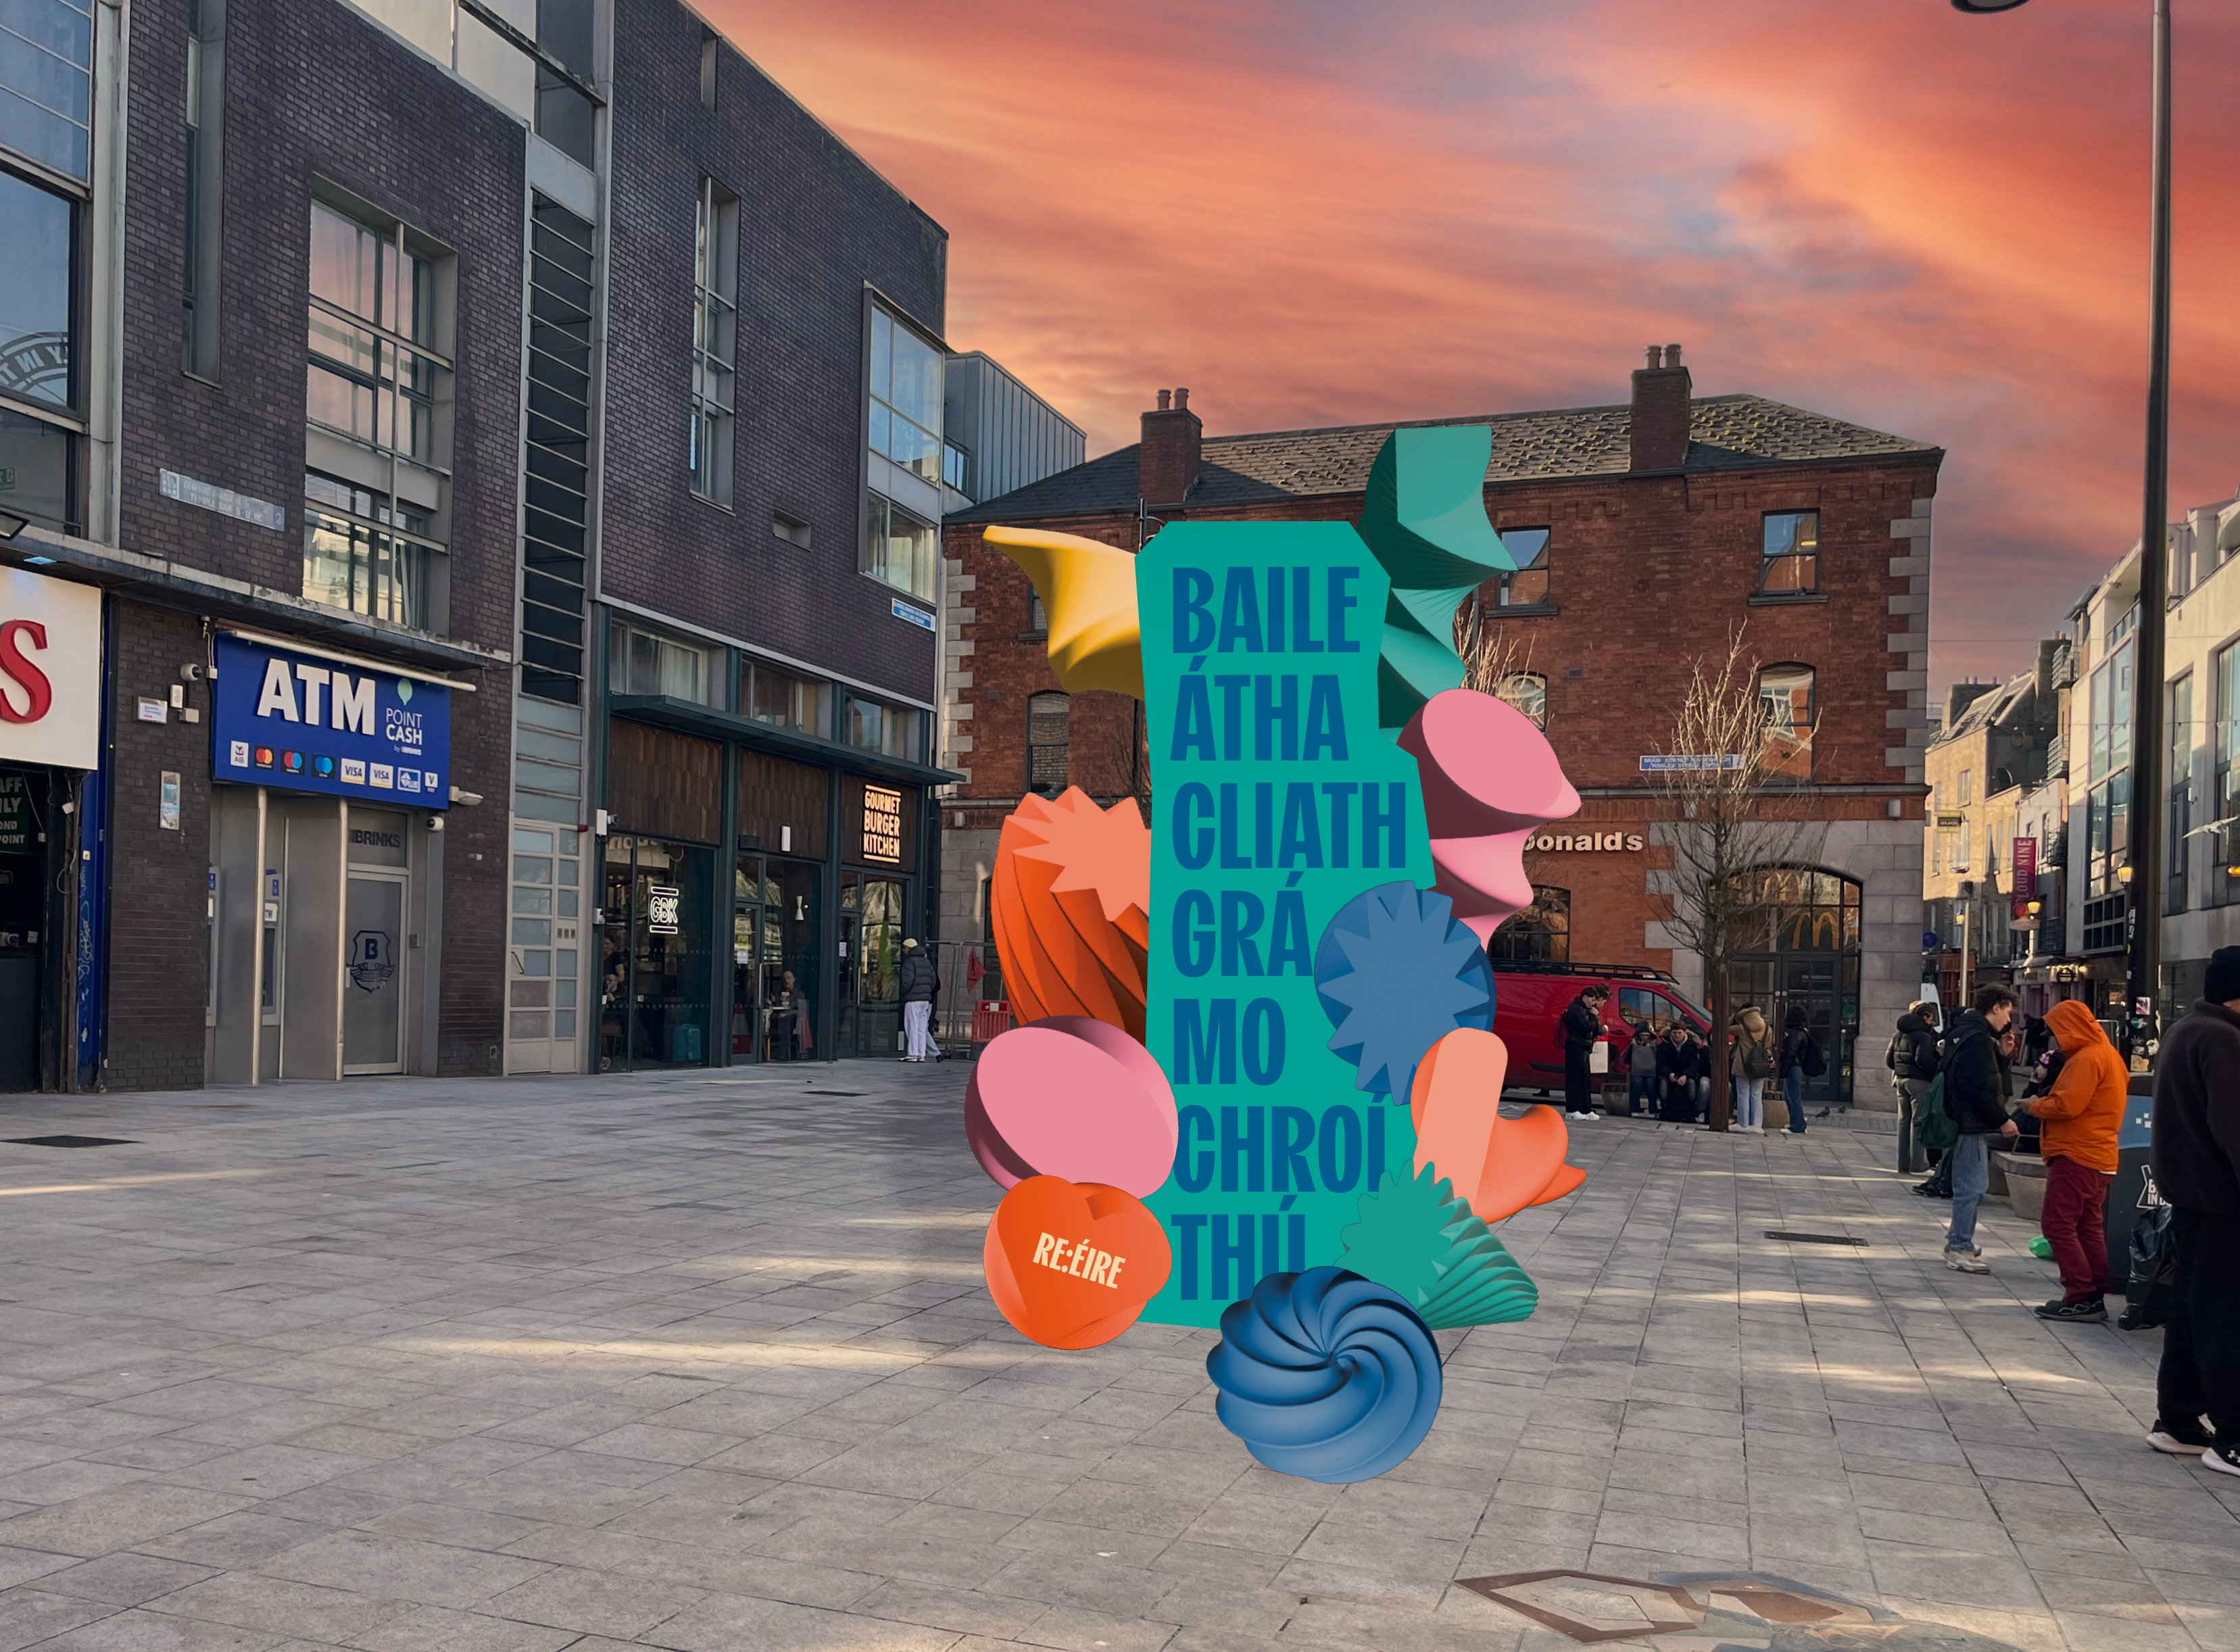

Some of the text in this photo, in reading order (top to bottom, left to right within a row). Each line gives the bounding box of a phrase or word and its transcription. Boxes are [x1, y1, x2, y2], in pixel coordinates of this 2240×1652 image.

[191, 493, 216, 508] TEMPLE
[218, 502, 233, 513] BAR
[274, 512, 282, 525] 2
[257, 658, 376, 735] ATM
[386, 708, 422, 728] POINT
[386, 724, 422, 745] CASH
[235, 756, 244, 764] AIB
[345, 766, 362, 777] VISA
[373, 769, 389, 780] VISA
[429, 775, 435, 785] V
[406, 780, 418, 789] PLUS
[865, 791, 901, 815] GOURMET
[864, 810, 900, 837] BURGER
[355, 829, 401, 848] BRINKS
[863, 833, 900, 858] KITCHEN
[2017, 840, 2032, 866] NINE
[650, 896, 678, 923] GBK
[365, 938, 379, 960] B
[2147, 1194, 2158, 1205] IN
